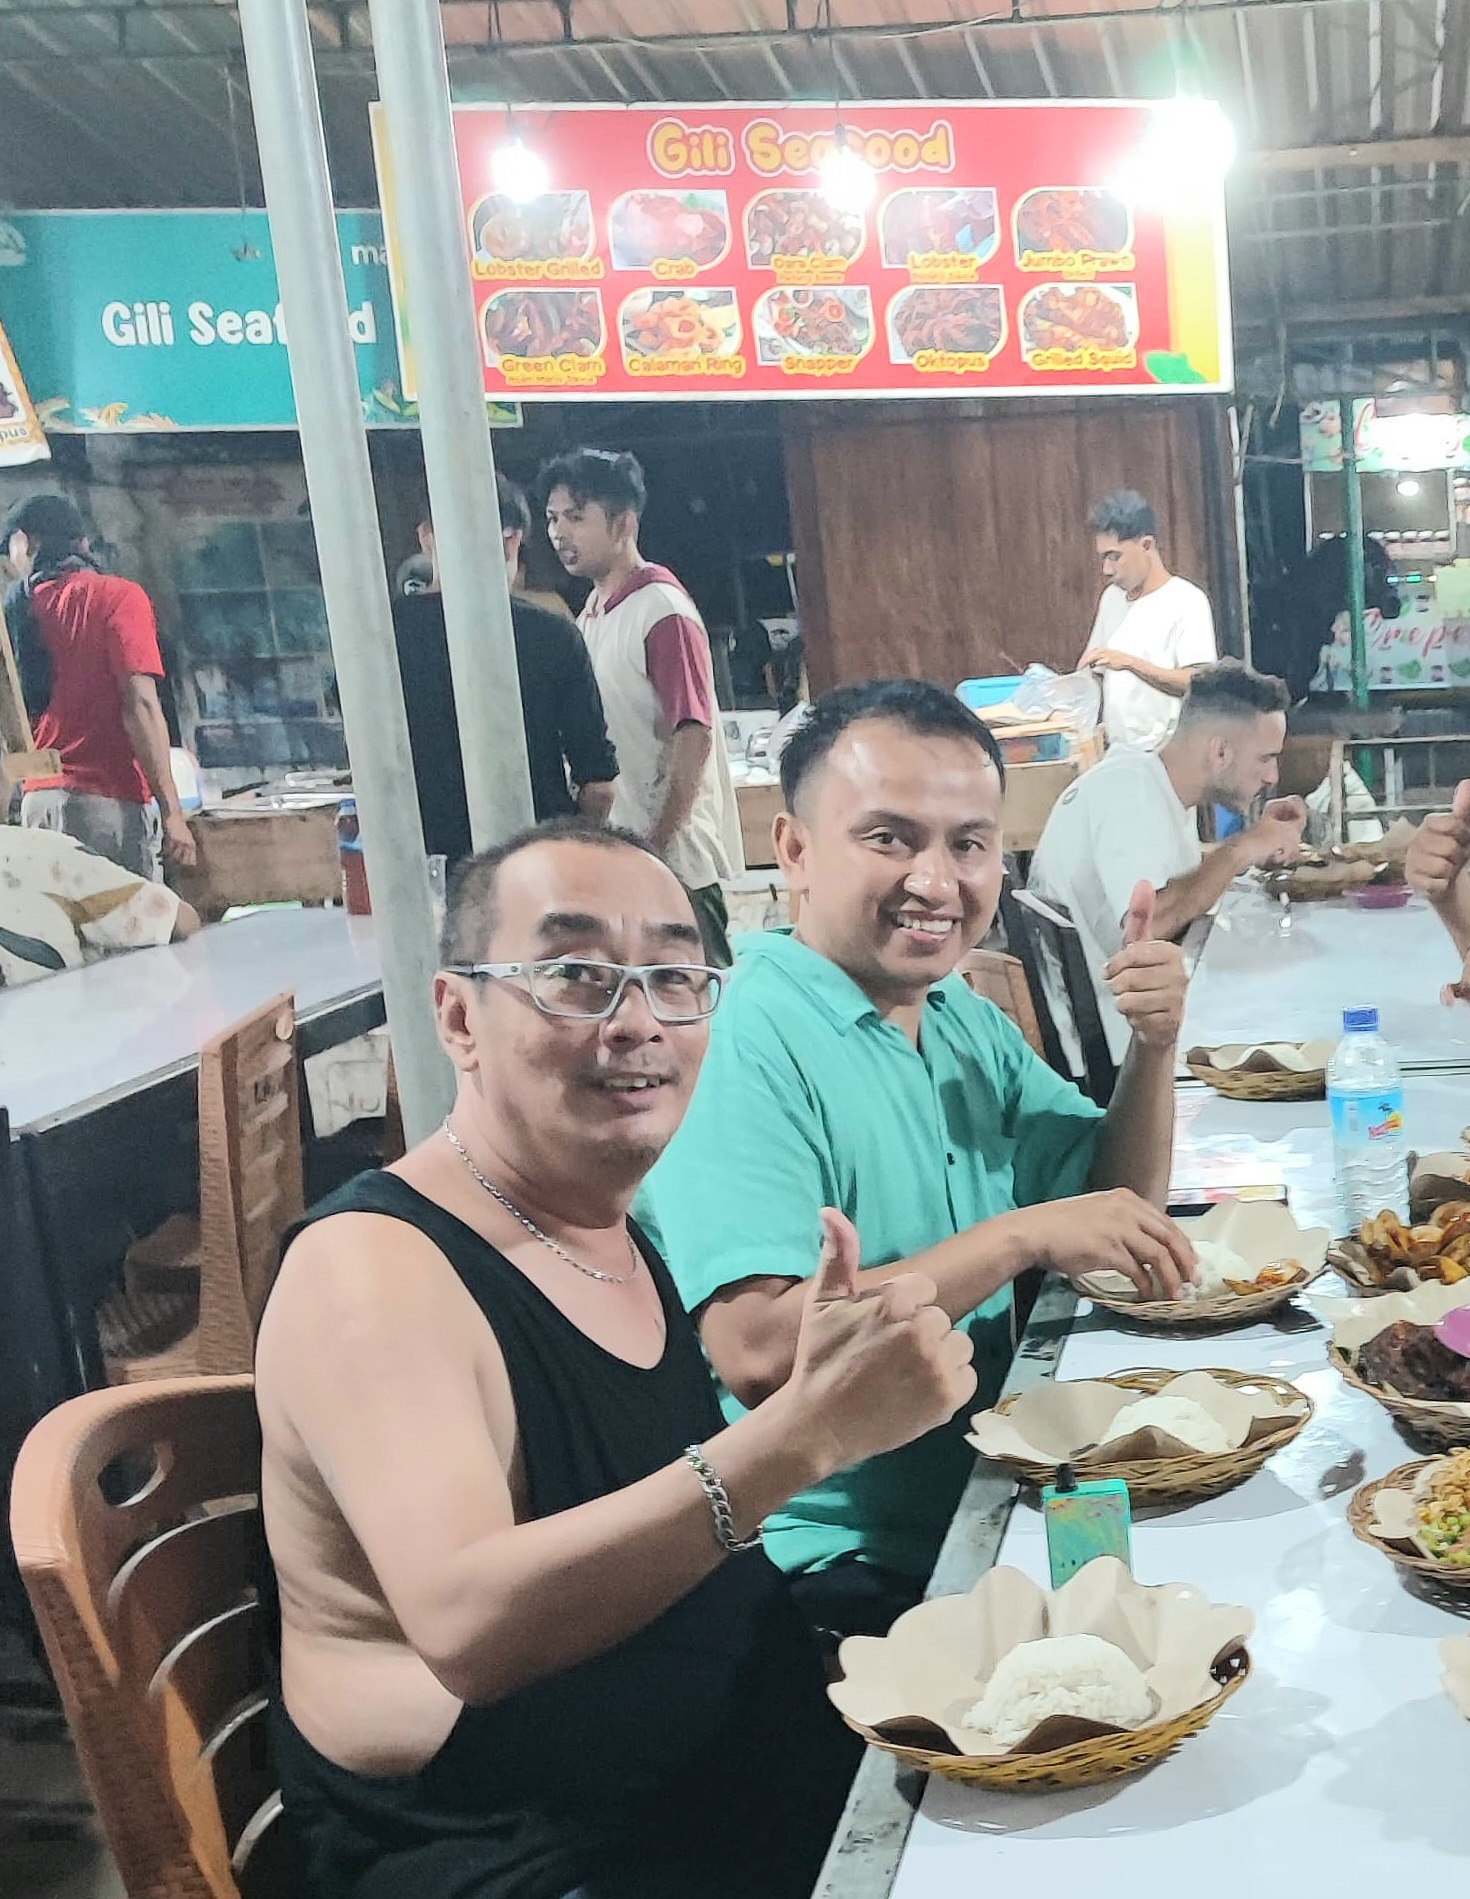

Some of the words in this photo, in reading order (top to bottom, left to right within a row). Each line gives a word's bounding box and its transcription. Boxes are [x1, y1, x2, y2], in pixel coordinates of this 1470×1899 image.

[650, 121, 732, 175] Gili
[746, 120, 952, 175] Seaood
[474, 259, 541, 276] Lobster
[911, 254, 977, 269] Lobster
[1023, 252, 1076, 267] Jumbo
[654, 261, 696, 276] Crab
[102, 302, 173, 345] Gili
[188, 301, 377, 345] Seafd
[502, 357, 554, 372] Green
[559, 356, 602, 372] Clam
[706, 357, 743, 375] Ring
[784, 355, 855, 374] Snapper
[1032, 350, 1083, 367] Grilled
